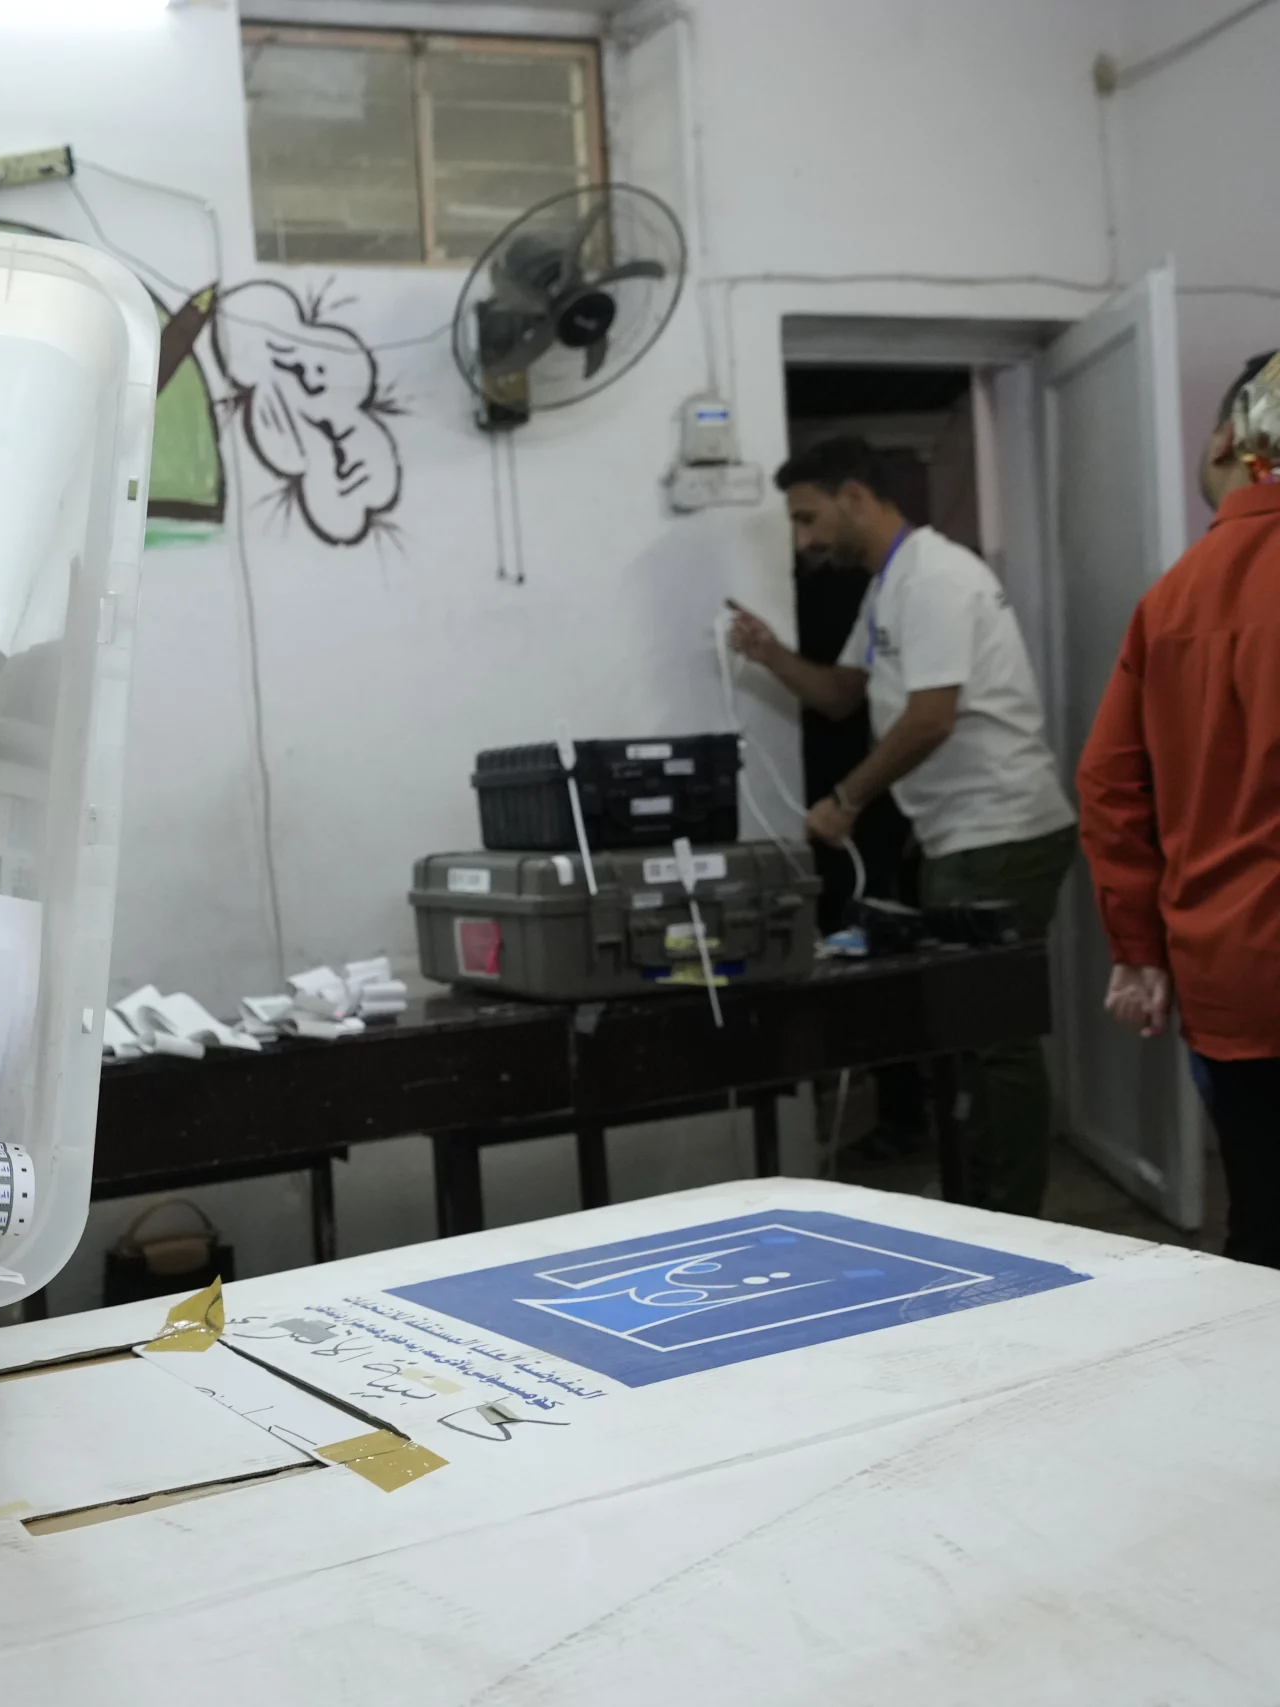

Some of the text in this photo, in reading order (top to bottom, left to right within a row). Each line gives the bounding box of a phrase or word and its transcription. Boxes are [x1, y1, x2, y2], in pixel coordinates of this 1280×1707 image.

[342, 1296, 609, 1400] المفوضية العليا المستقلة للانتخابات
